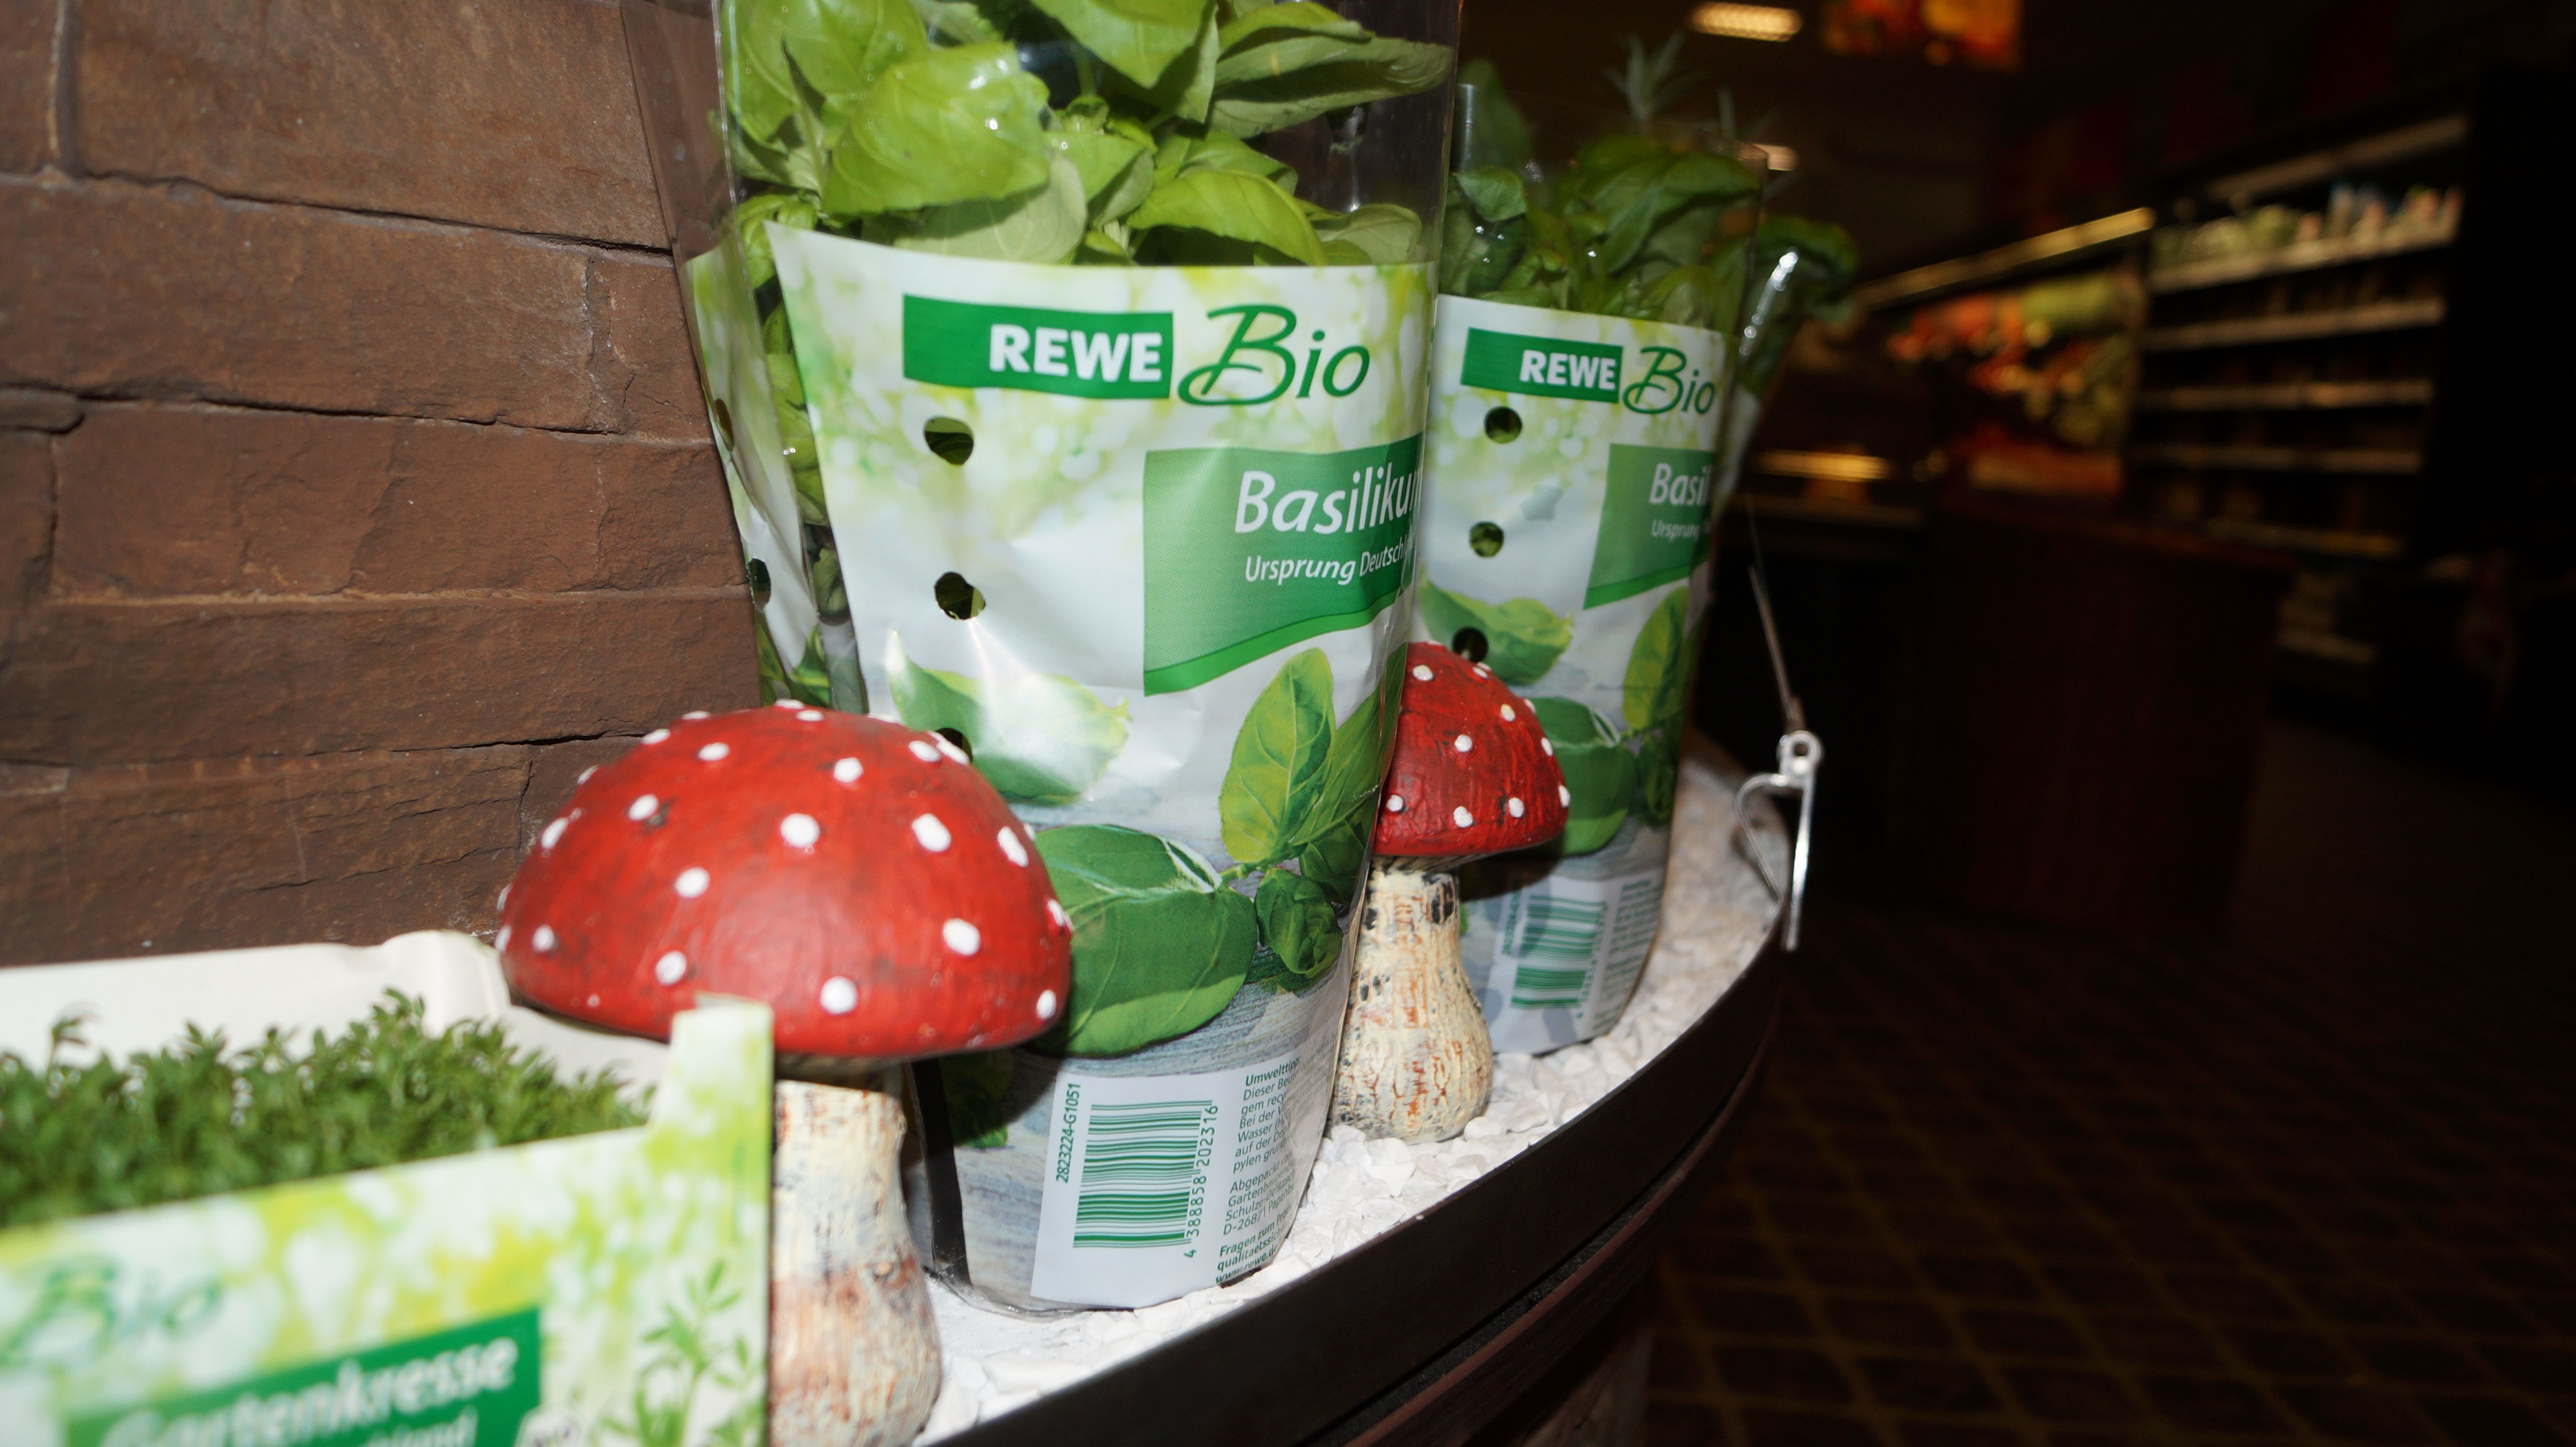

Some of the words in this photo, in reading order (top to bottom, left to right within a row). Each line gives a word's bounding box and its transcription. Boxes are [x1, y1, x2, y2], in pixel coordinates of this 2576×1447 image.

[989, 324, 1163, 383] REWE
[1178, 304, 1370, 407] Bio
[1519, 349, 1616, 391] REWE
[1623, 346, 1715, 415] Bio
[1245, 555, 1356, 586] Ursprung
[1245, 1056, 1302, 1087] Umwelttipp:
[1243, 1083, 1276, 1101] Dieser
[1239, 1117, 1255, 1130] Bei
[1258, 1111, 1275, 1124] der
[1241, 1101, 1264, 1118] gem
[1056, 1082, 1081, 1183] 2823224-G1051
[1195, 1105, 1219, 1167] 202316
[1235, 1141, 1254, 1158] auf
[1255, 1136, 1272, 1151] der
[1237, 1124, 1273, 1143] Wasser
[1230, 1161, 1280, 1194] Abgepackt
[1233, 1154, 1262, 1174] pylen
[1186, 1175, 1207, 1238] 388858
[1223, 1206, 1266, 1236] D-26871
[1184, 1249, 1197, 1259] 4
[1220, 1234, 1256, 1257] Fragen
[1258, 1221, 1275, 1239] zum
